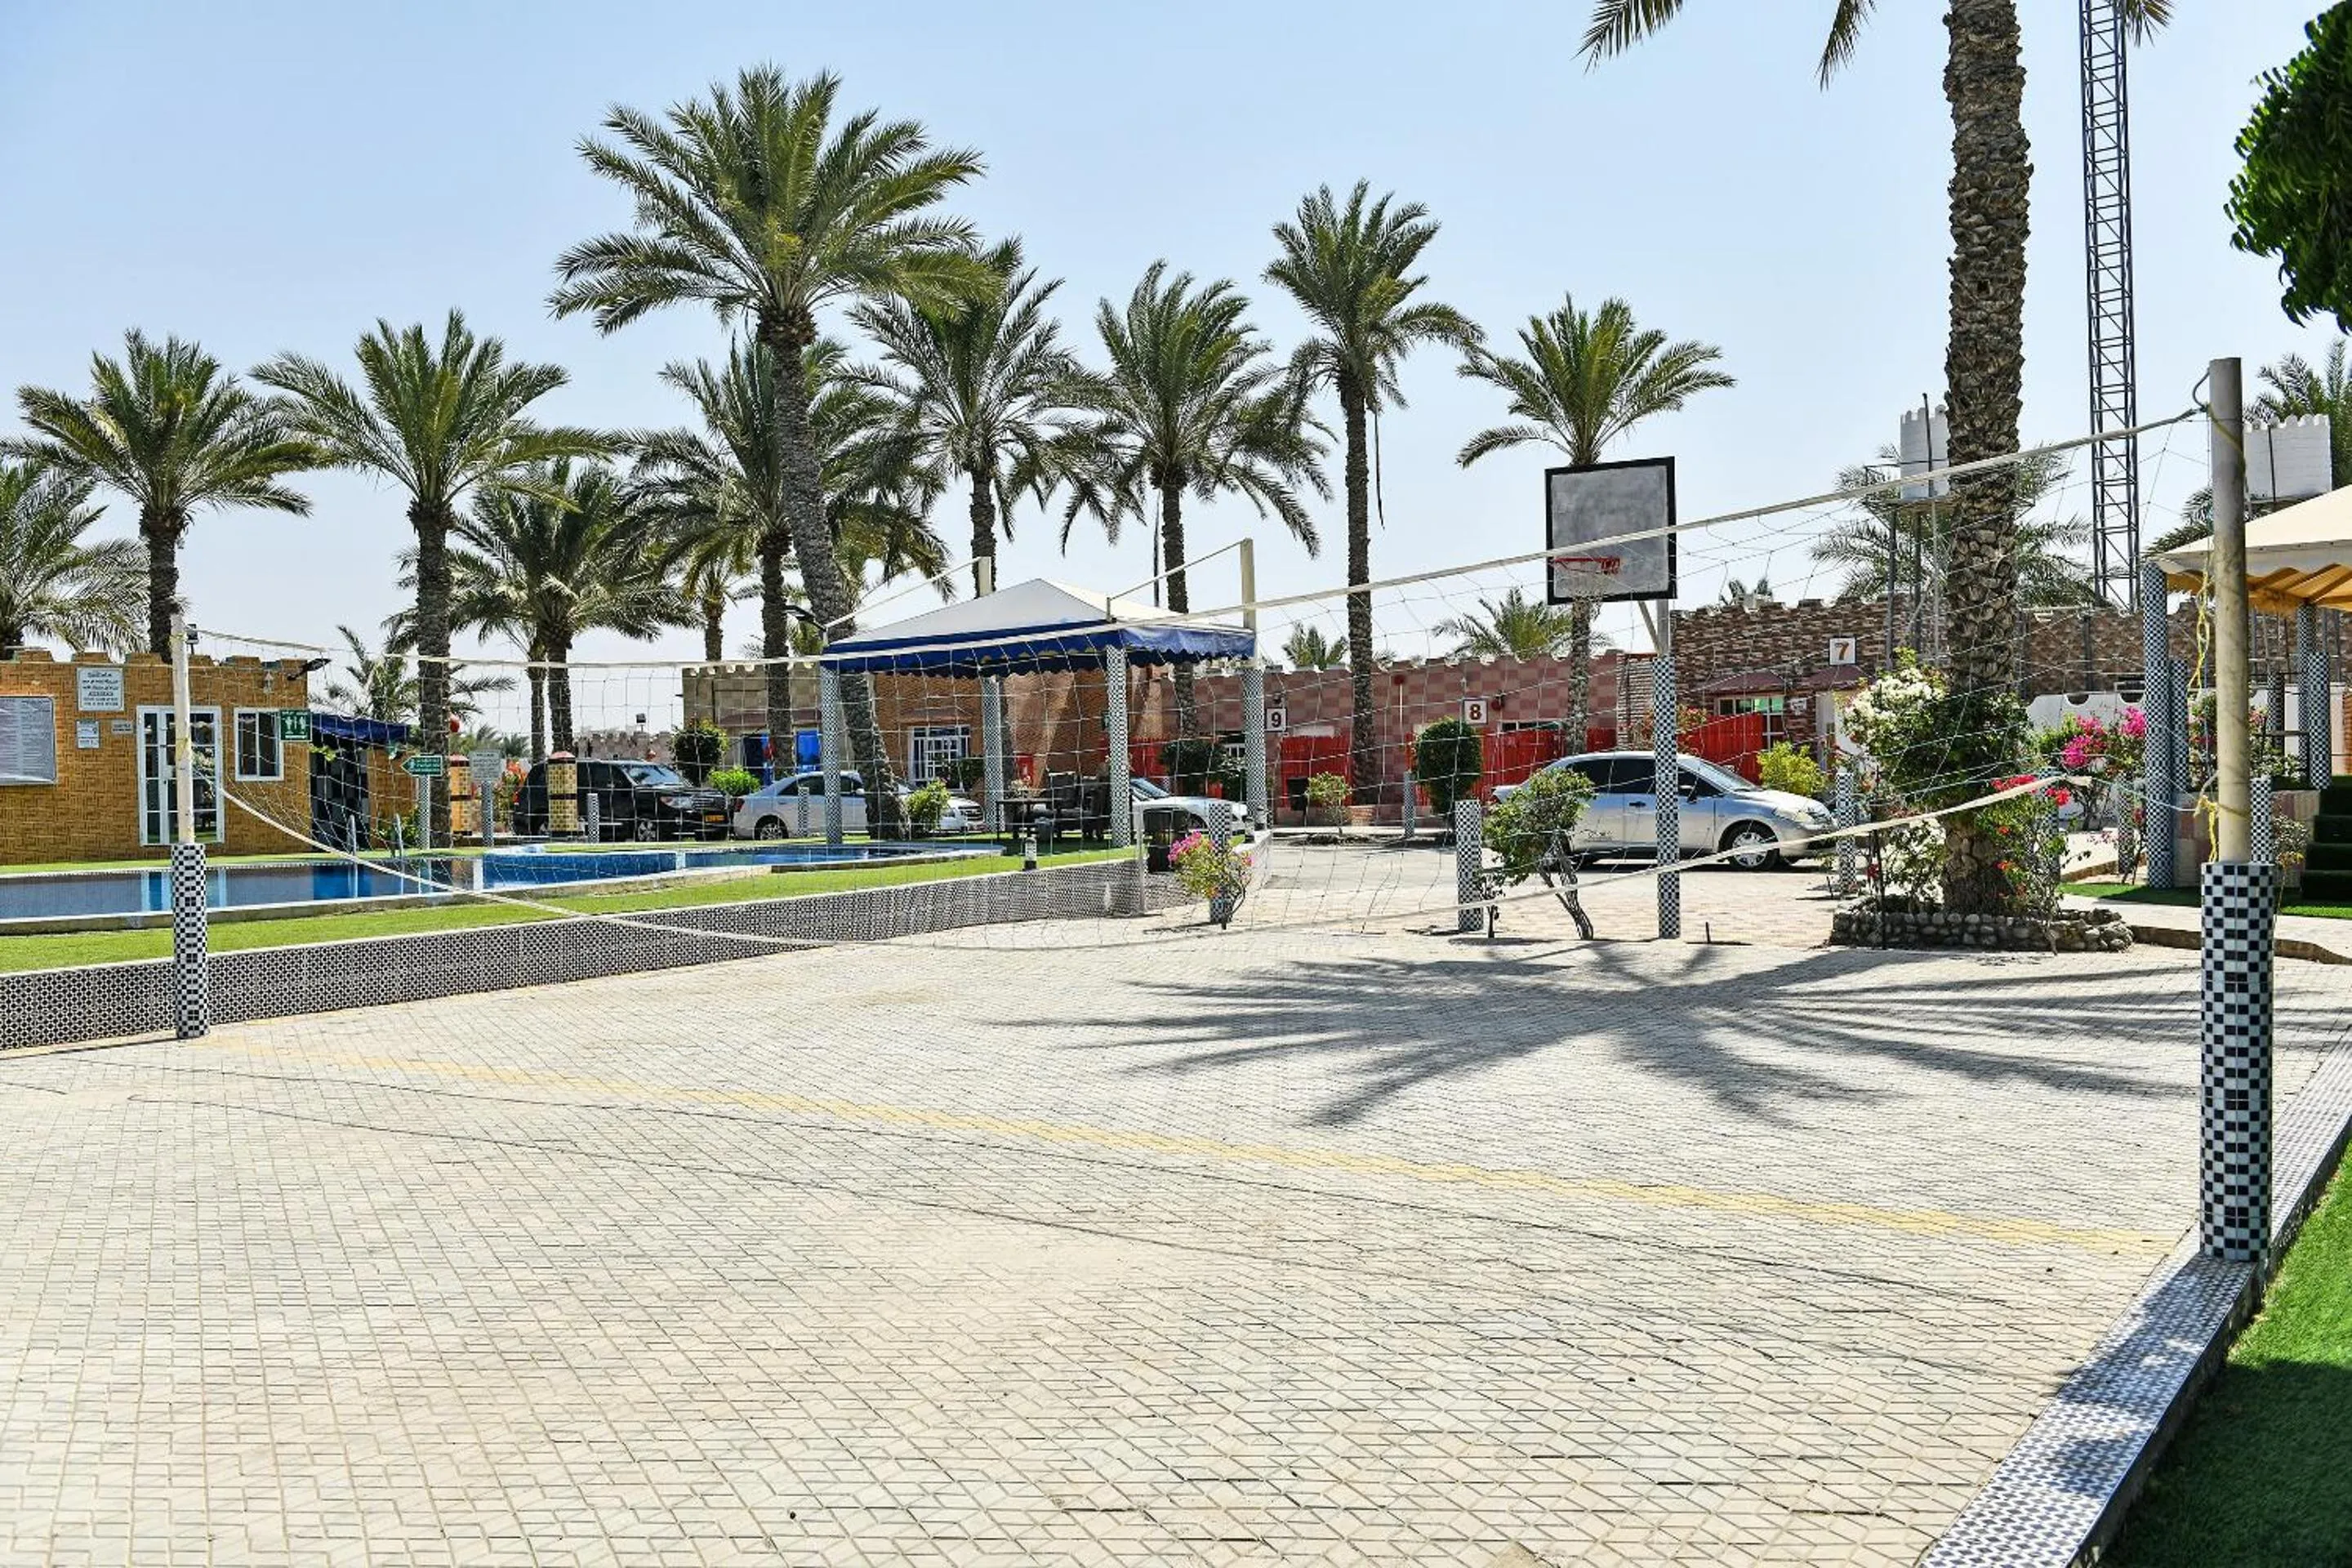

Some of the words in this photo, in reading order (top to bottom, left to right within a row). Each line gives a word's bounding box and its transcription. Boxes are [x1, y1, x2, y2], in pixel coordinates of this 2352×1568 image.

[1835, 642, 1849, 660] 7
[1272, 711, 1281, 728] 9
[1470, 704, 1481, 719] 8
